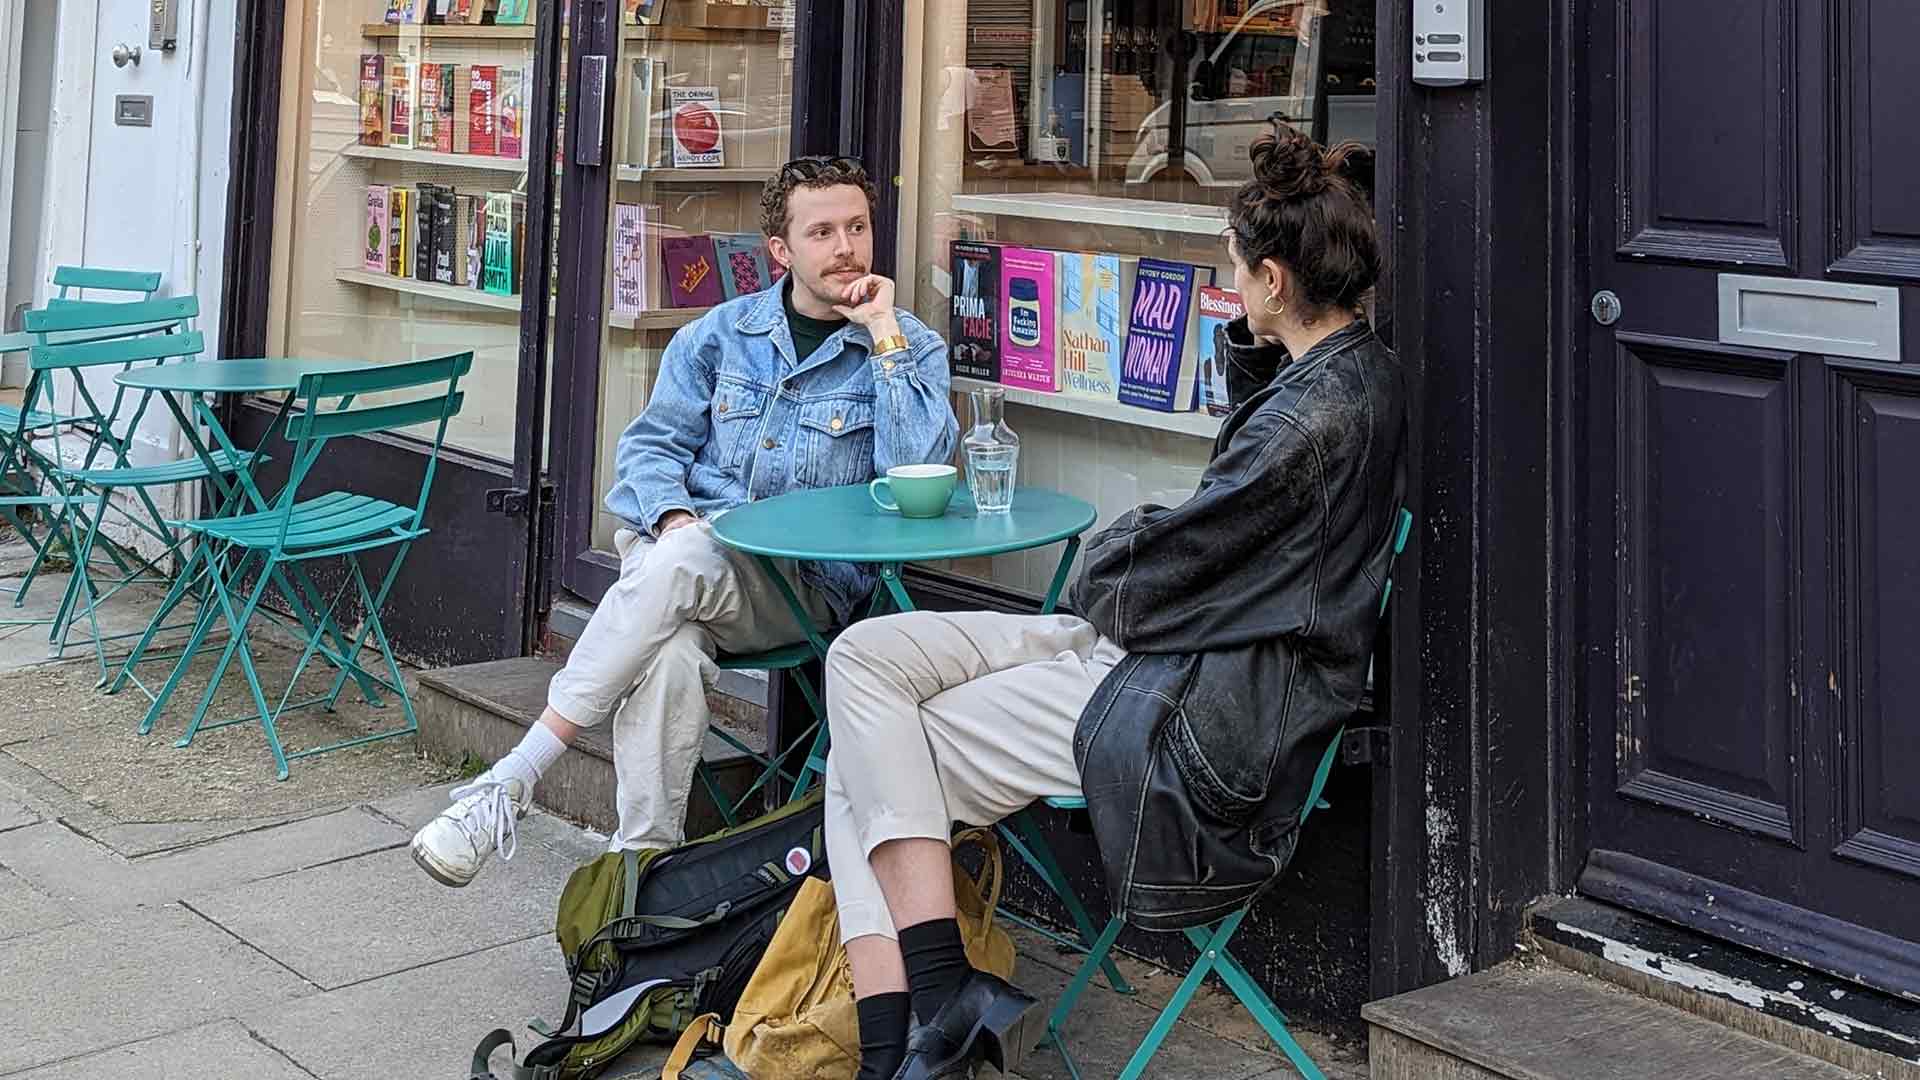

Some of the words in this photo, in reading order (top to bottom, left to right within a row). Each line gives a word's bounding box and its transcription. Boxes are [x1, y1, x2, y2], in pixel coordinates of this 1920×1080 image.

[953, 295, 985, 319] PRIMA
[1133, 280, 1181, 330] MAD
[1200, 292, 1242, 320] Blessings
[963, 317, 992, 340] FACIE
[1063, 330, 1110, 353] Nathan
[1063, 350, 1086, 373] Hill
[1124, 333, 1173, 386] WOMAN
[1064, 369, 1111, 394] Wellness
